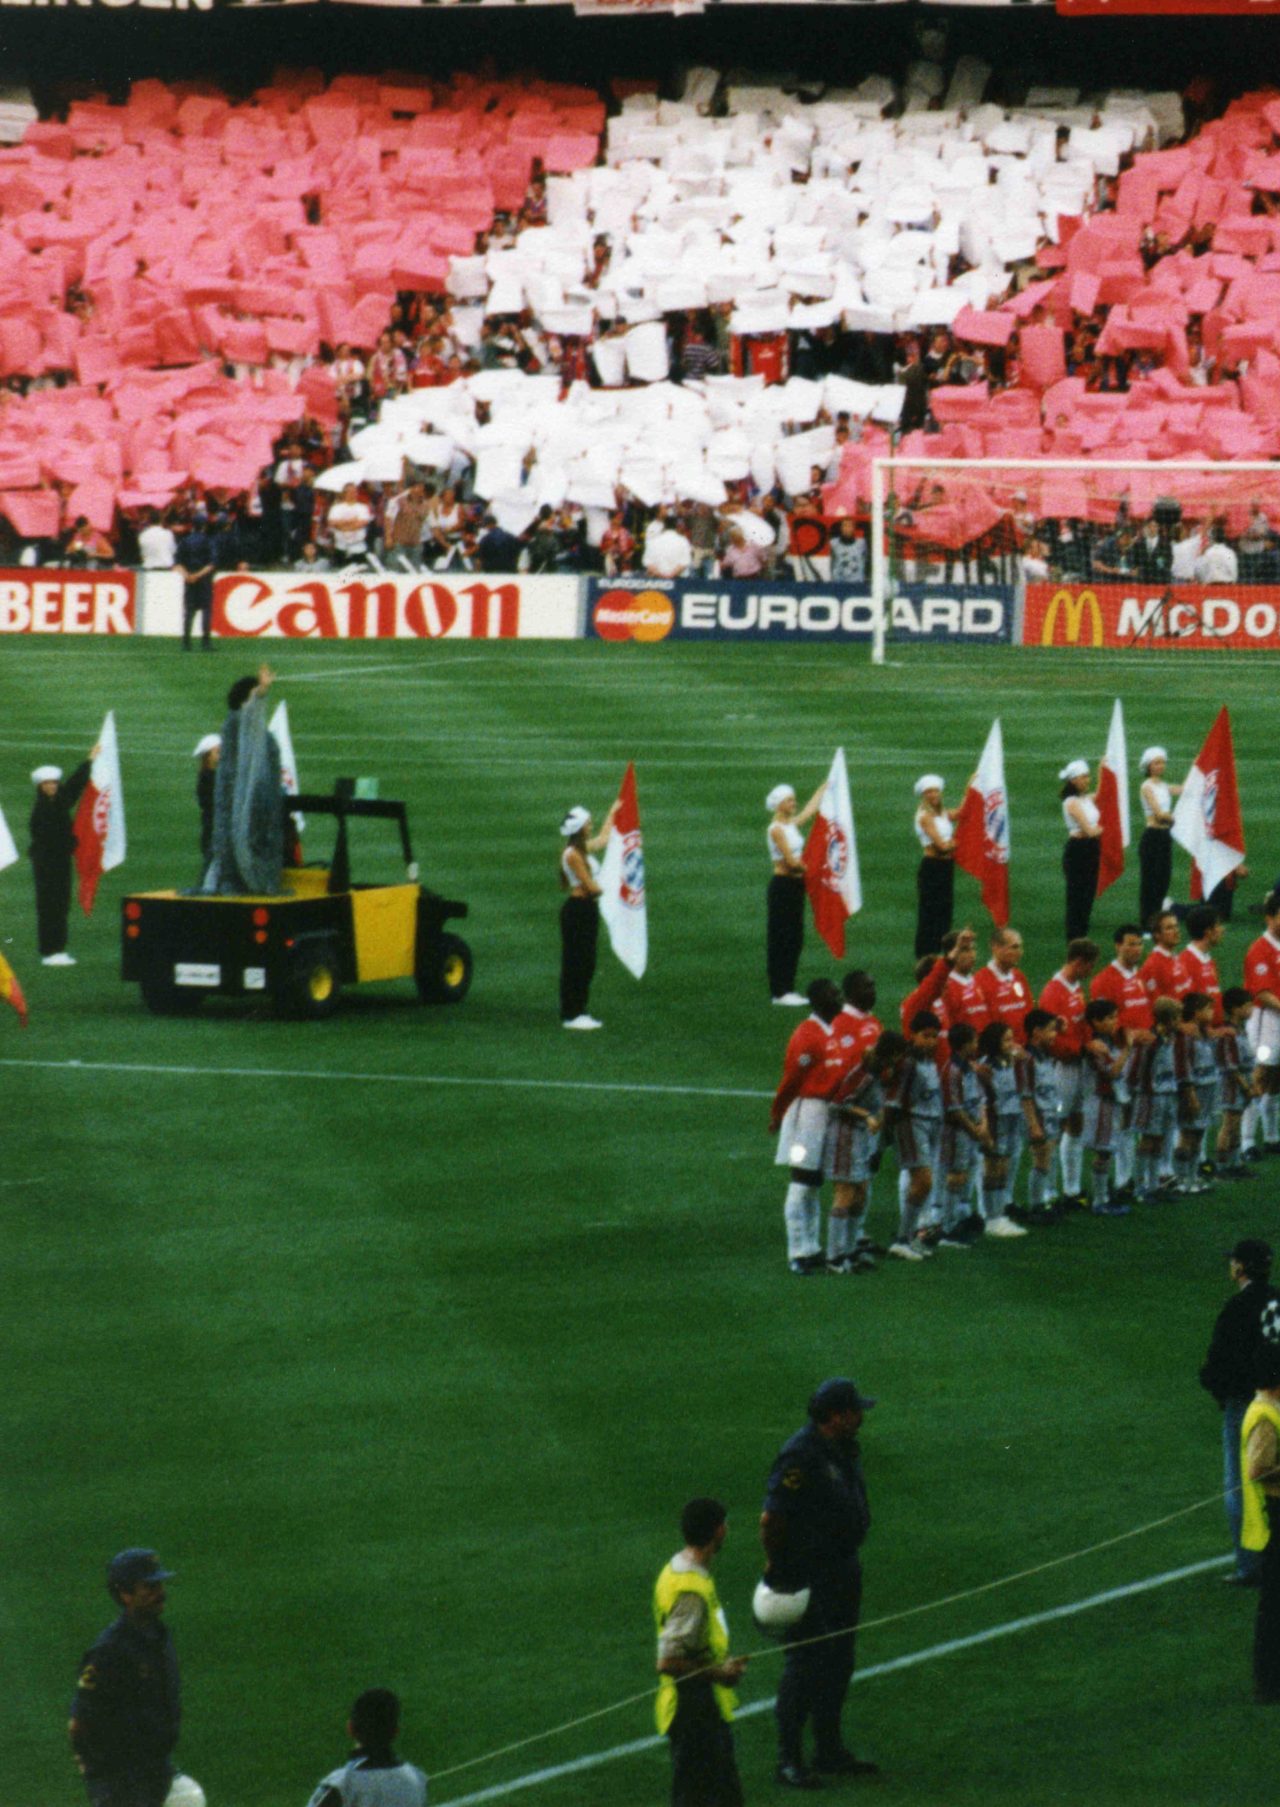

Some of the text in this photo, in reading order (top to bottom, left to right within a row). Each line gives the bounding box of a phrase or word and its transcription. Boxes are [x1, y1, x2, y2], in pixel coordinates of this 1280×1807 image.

[0, 581, 133, 634] BEER
[211, 575, 520, 638] Canon
[681, 593, 1004, 634] EUROCARD
